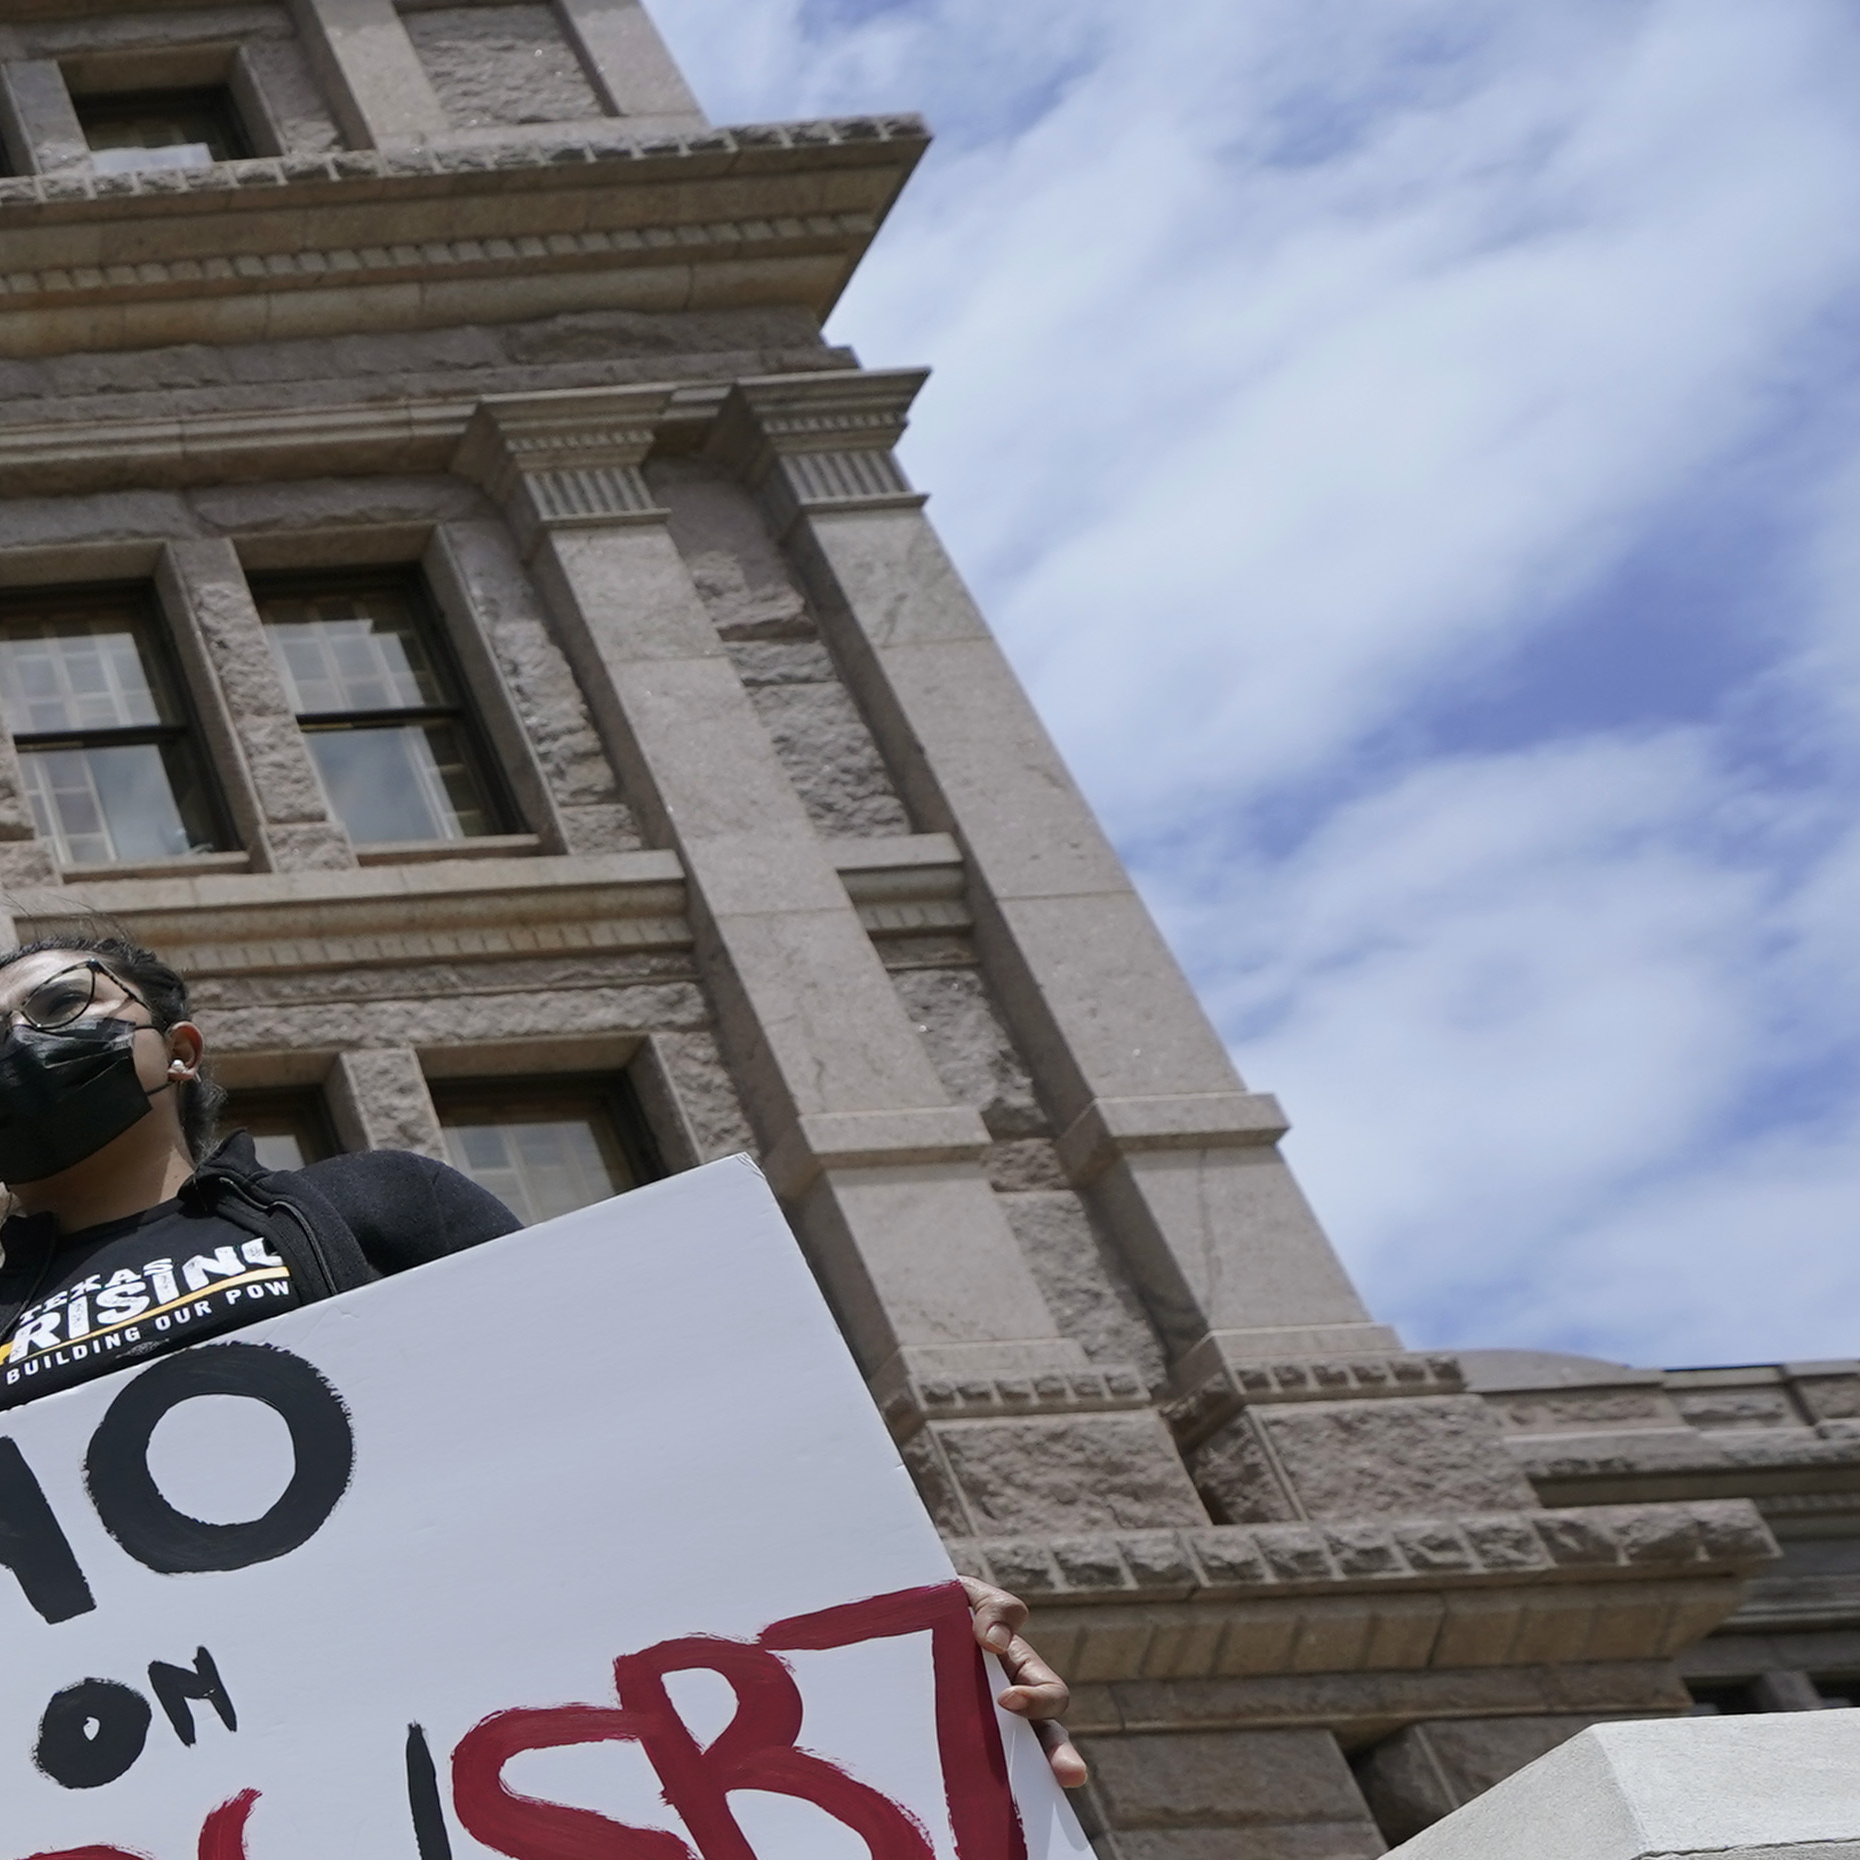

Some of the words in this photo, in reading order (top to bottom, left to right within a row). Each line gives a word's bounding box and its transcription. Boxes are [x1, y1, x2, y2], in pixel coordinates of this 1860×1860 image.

[6, 1327, 142, 1386] BUILDING
[154, 1300, 212, 1332] OUR
[224, 1280, 290, 1306] POW
[19, 1257, 175, 1326] TEXAS
[32, 1644, 238, 1790] ON
